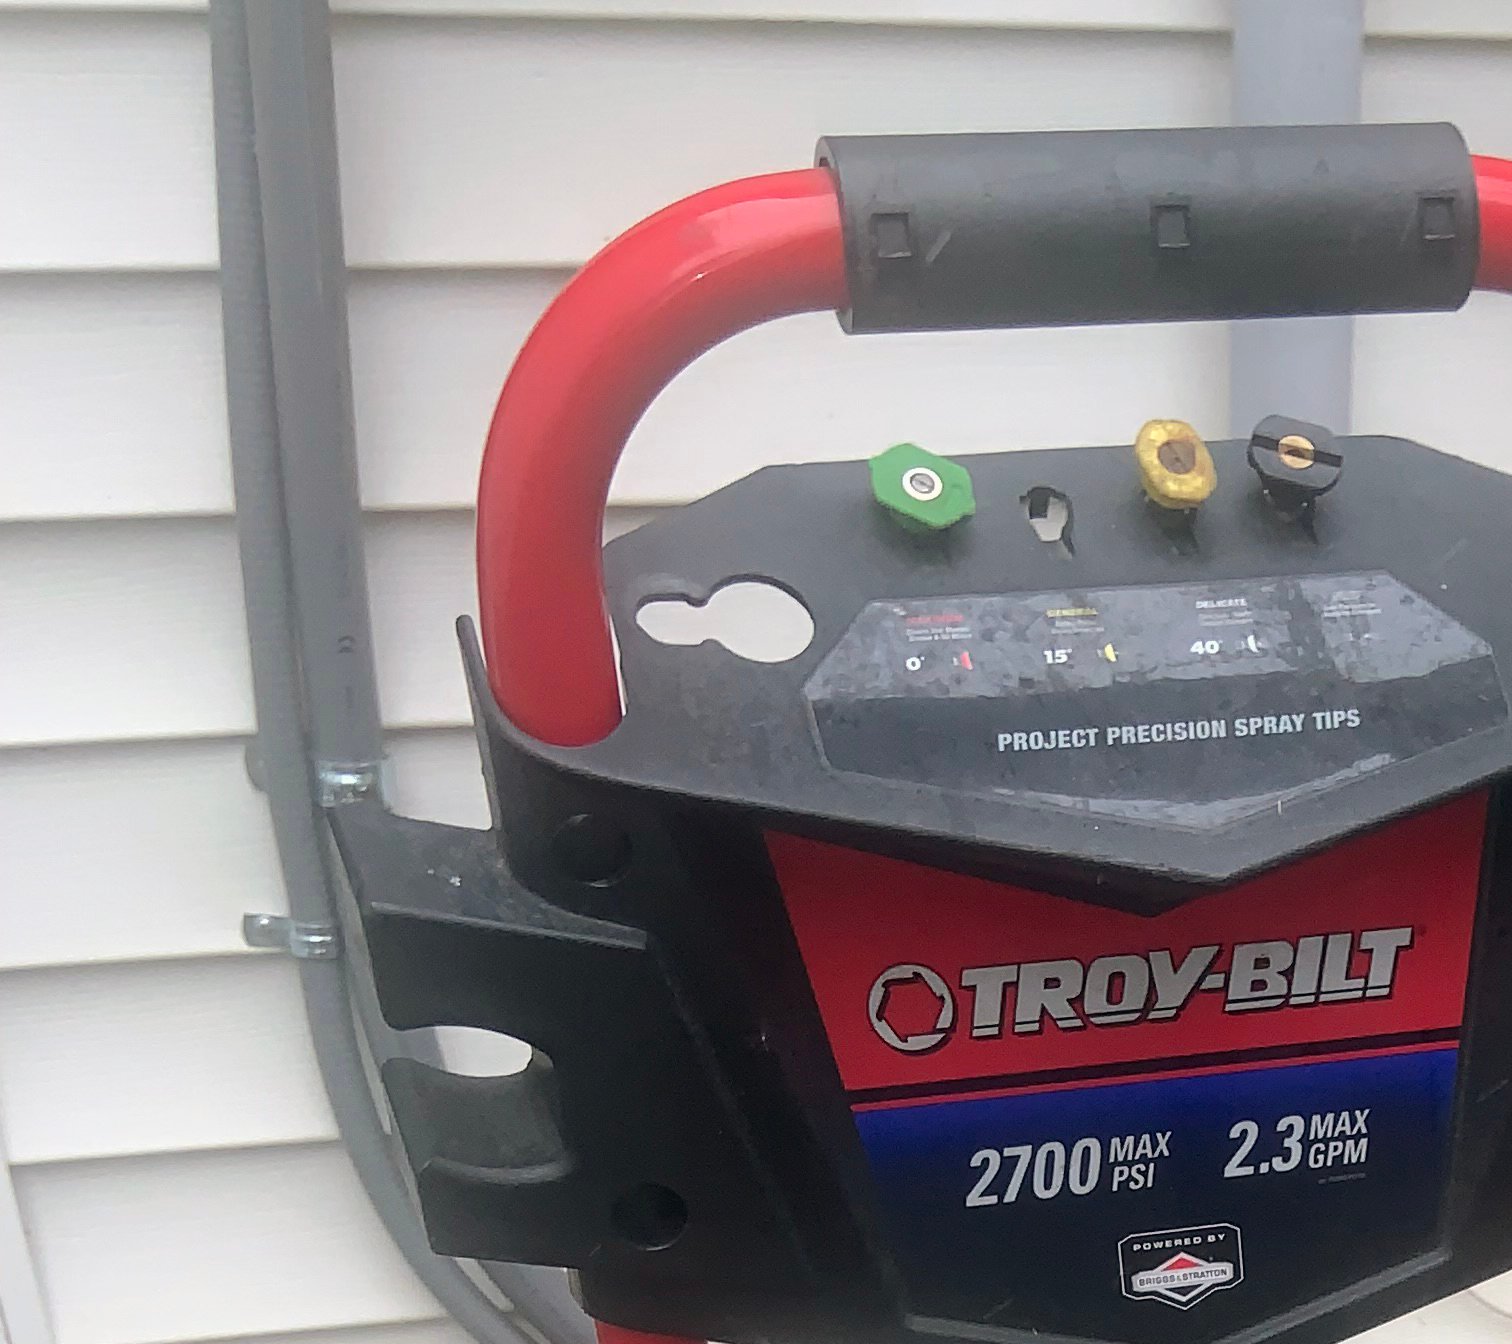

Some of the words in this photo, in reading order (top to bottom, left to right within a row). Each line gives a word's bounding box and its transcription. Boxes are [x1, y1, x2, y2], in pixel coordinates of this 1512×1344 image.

[998, 727, 1099, 751] PROJECT
[1106, 719, 1227, 746] PRECISION
[1234, 713, 1305, 738] SPRAY
[1312, 708, 1362, 731] TIPS
[960, 926, 1413, 1040] TROY-BILT
[1308, 1108, 1373, 1141] MAX
[1108, 1130, 1173, 1165] MAX
[1223, 1115, 1307, 1179] 2.3
[1307, 1137, 1369, 1171] GPM
[965, 1137, 1102, 1209] 2700
[1111, 1161, 1157, 1193] PSI
[1132, 1236, 1202, 1252] POWERED
[1207, 1233, 1226, 1243] BY
